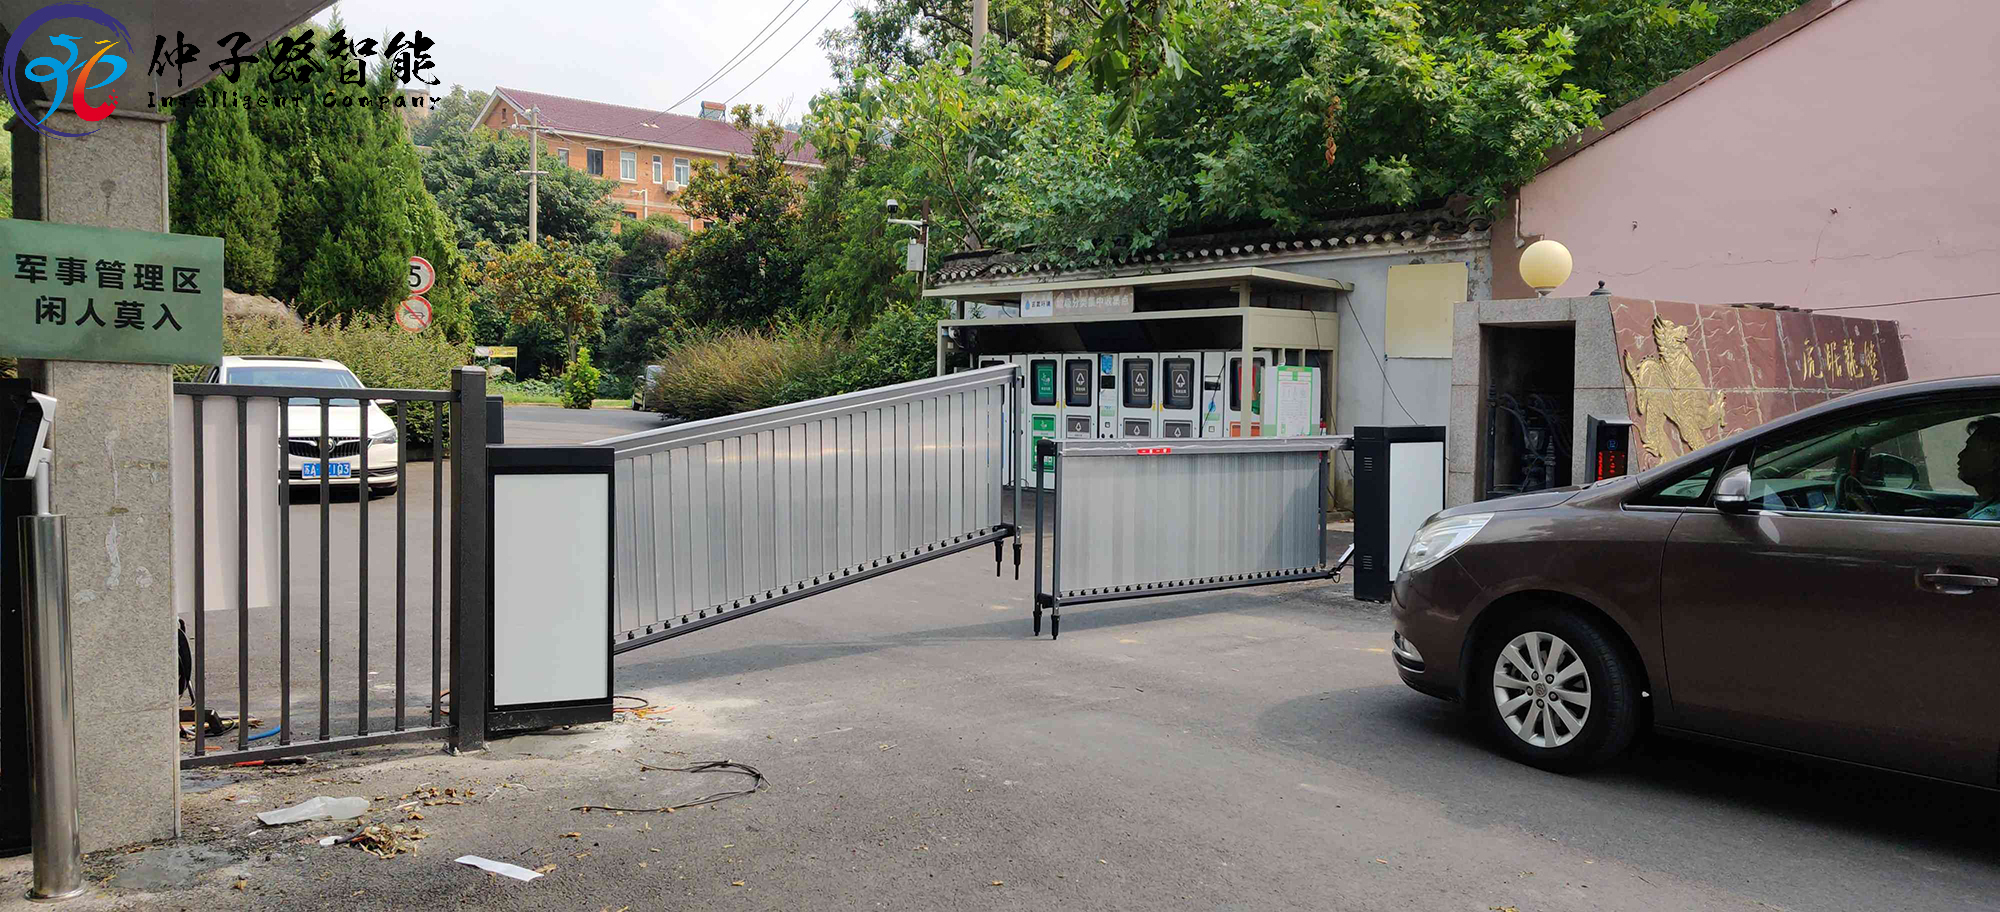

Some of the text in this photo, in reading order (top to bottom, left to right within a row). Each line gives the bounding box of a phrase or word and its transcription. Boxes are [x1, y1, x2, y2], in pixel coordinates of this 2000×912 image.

[15, 253, 201, 294] 军事管理区
[408, 265, 422, 287] 5
[35, 295, 182, 332] 闲人莫入
